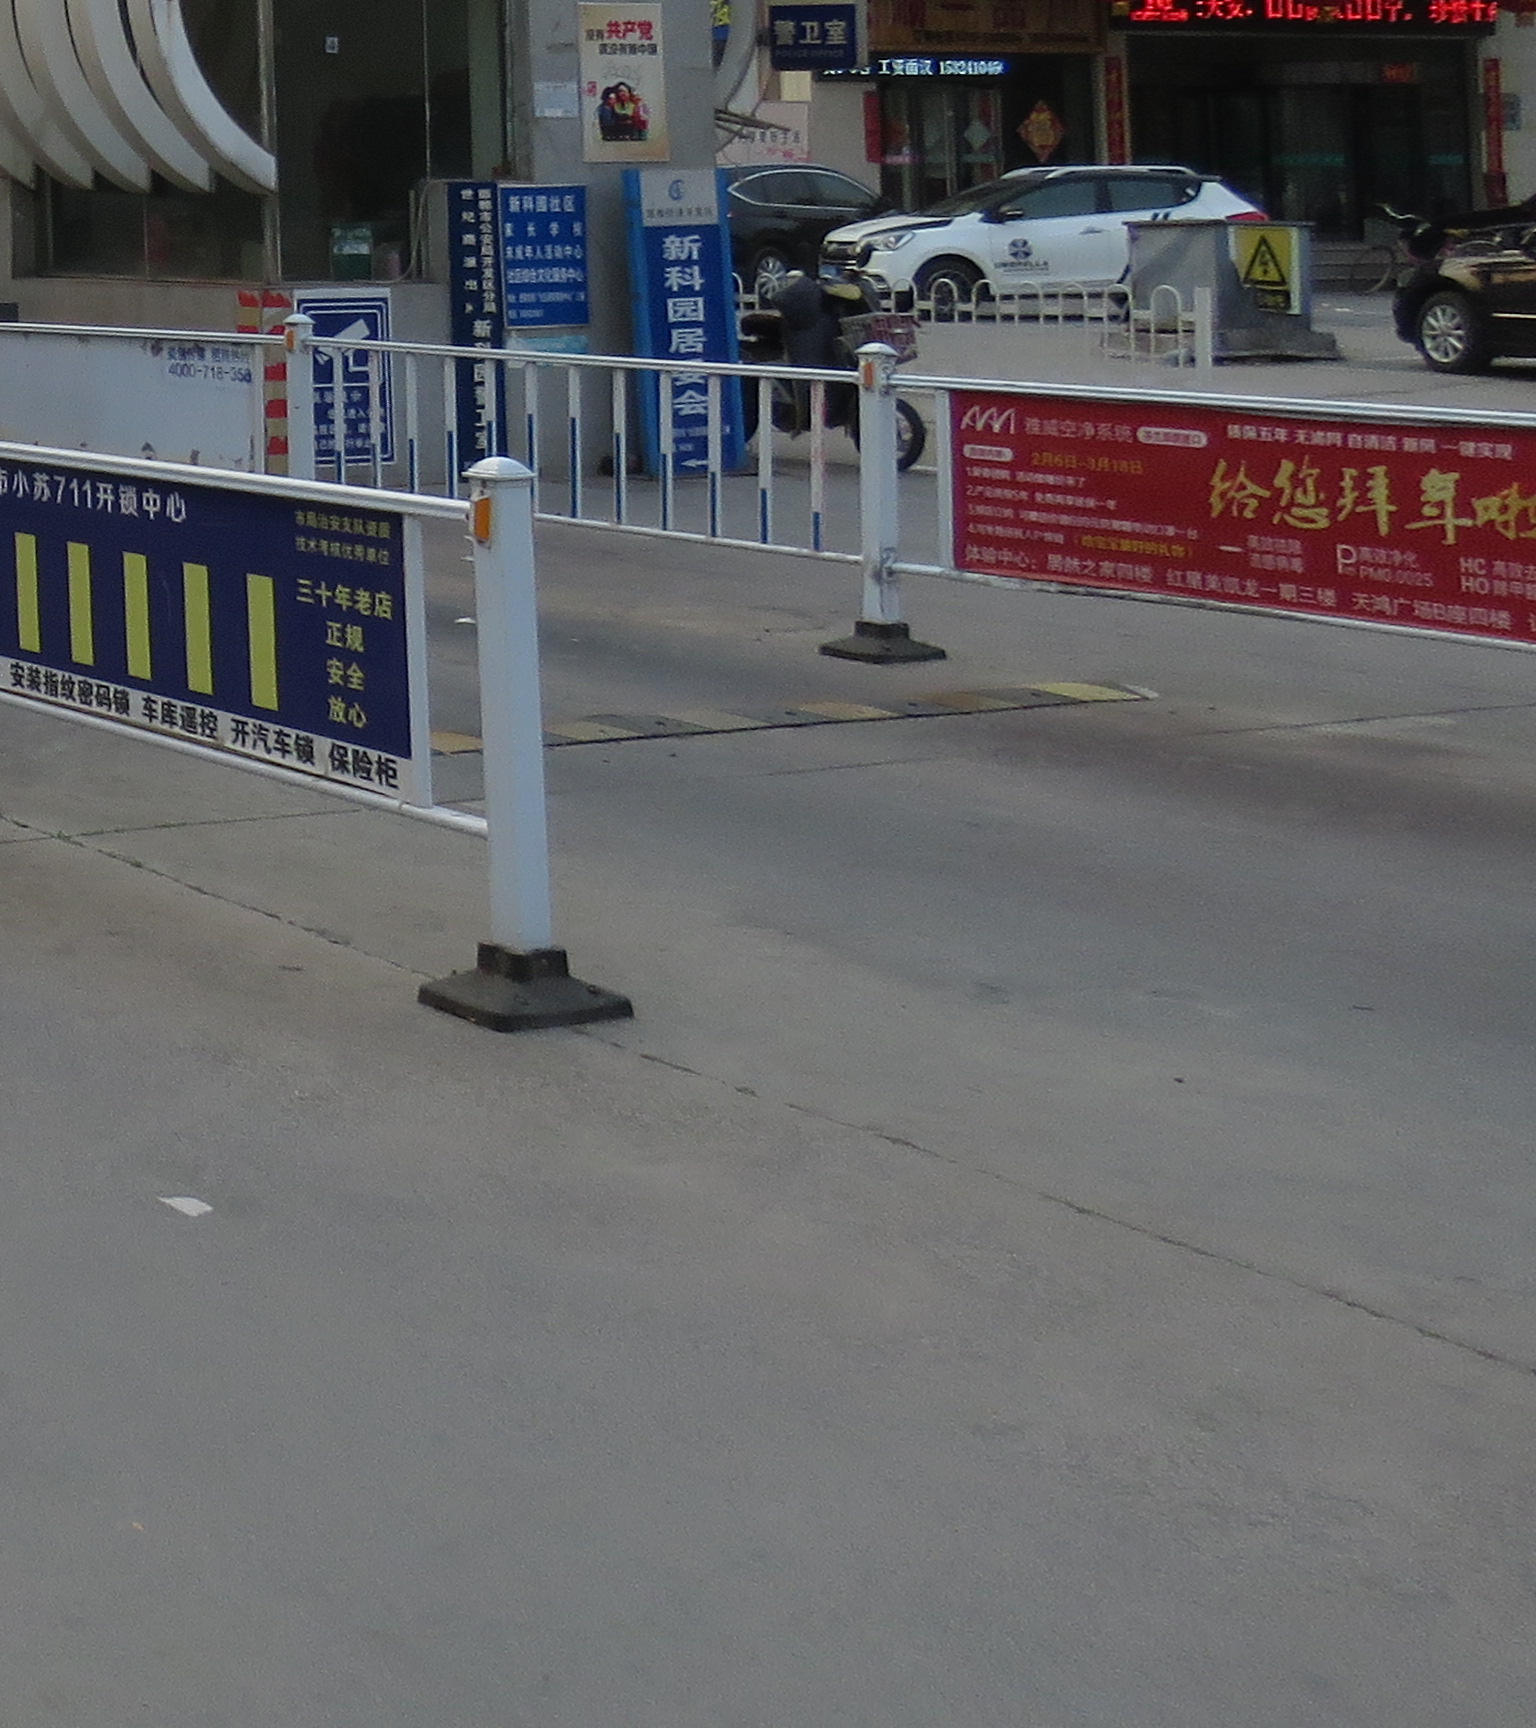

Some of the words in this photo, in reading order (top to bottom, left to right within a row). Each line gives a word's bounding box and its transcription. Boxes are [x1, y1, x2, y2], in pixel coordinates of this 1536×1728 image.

[773, 19, 849, 46] 警卫室
[508, 194, 576, 213] 新科园社区
[296, 577, 394, 622] 三十年老店
[325, 621, 365, 654] 正规
[326, 659, 366, 691] 安全
[9, 660, 131, 718] 安装指纹密码锁
[140, 694, 219, 741] 车库遥控
[230, 716, 317, 768] 开汽车锁
[328, 744, 401, 791] 保险柜
[328, 695, 369, 729] 放心
